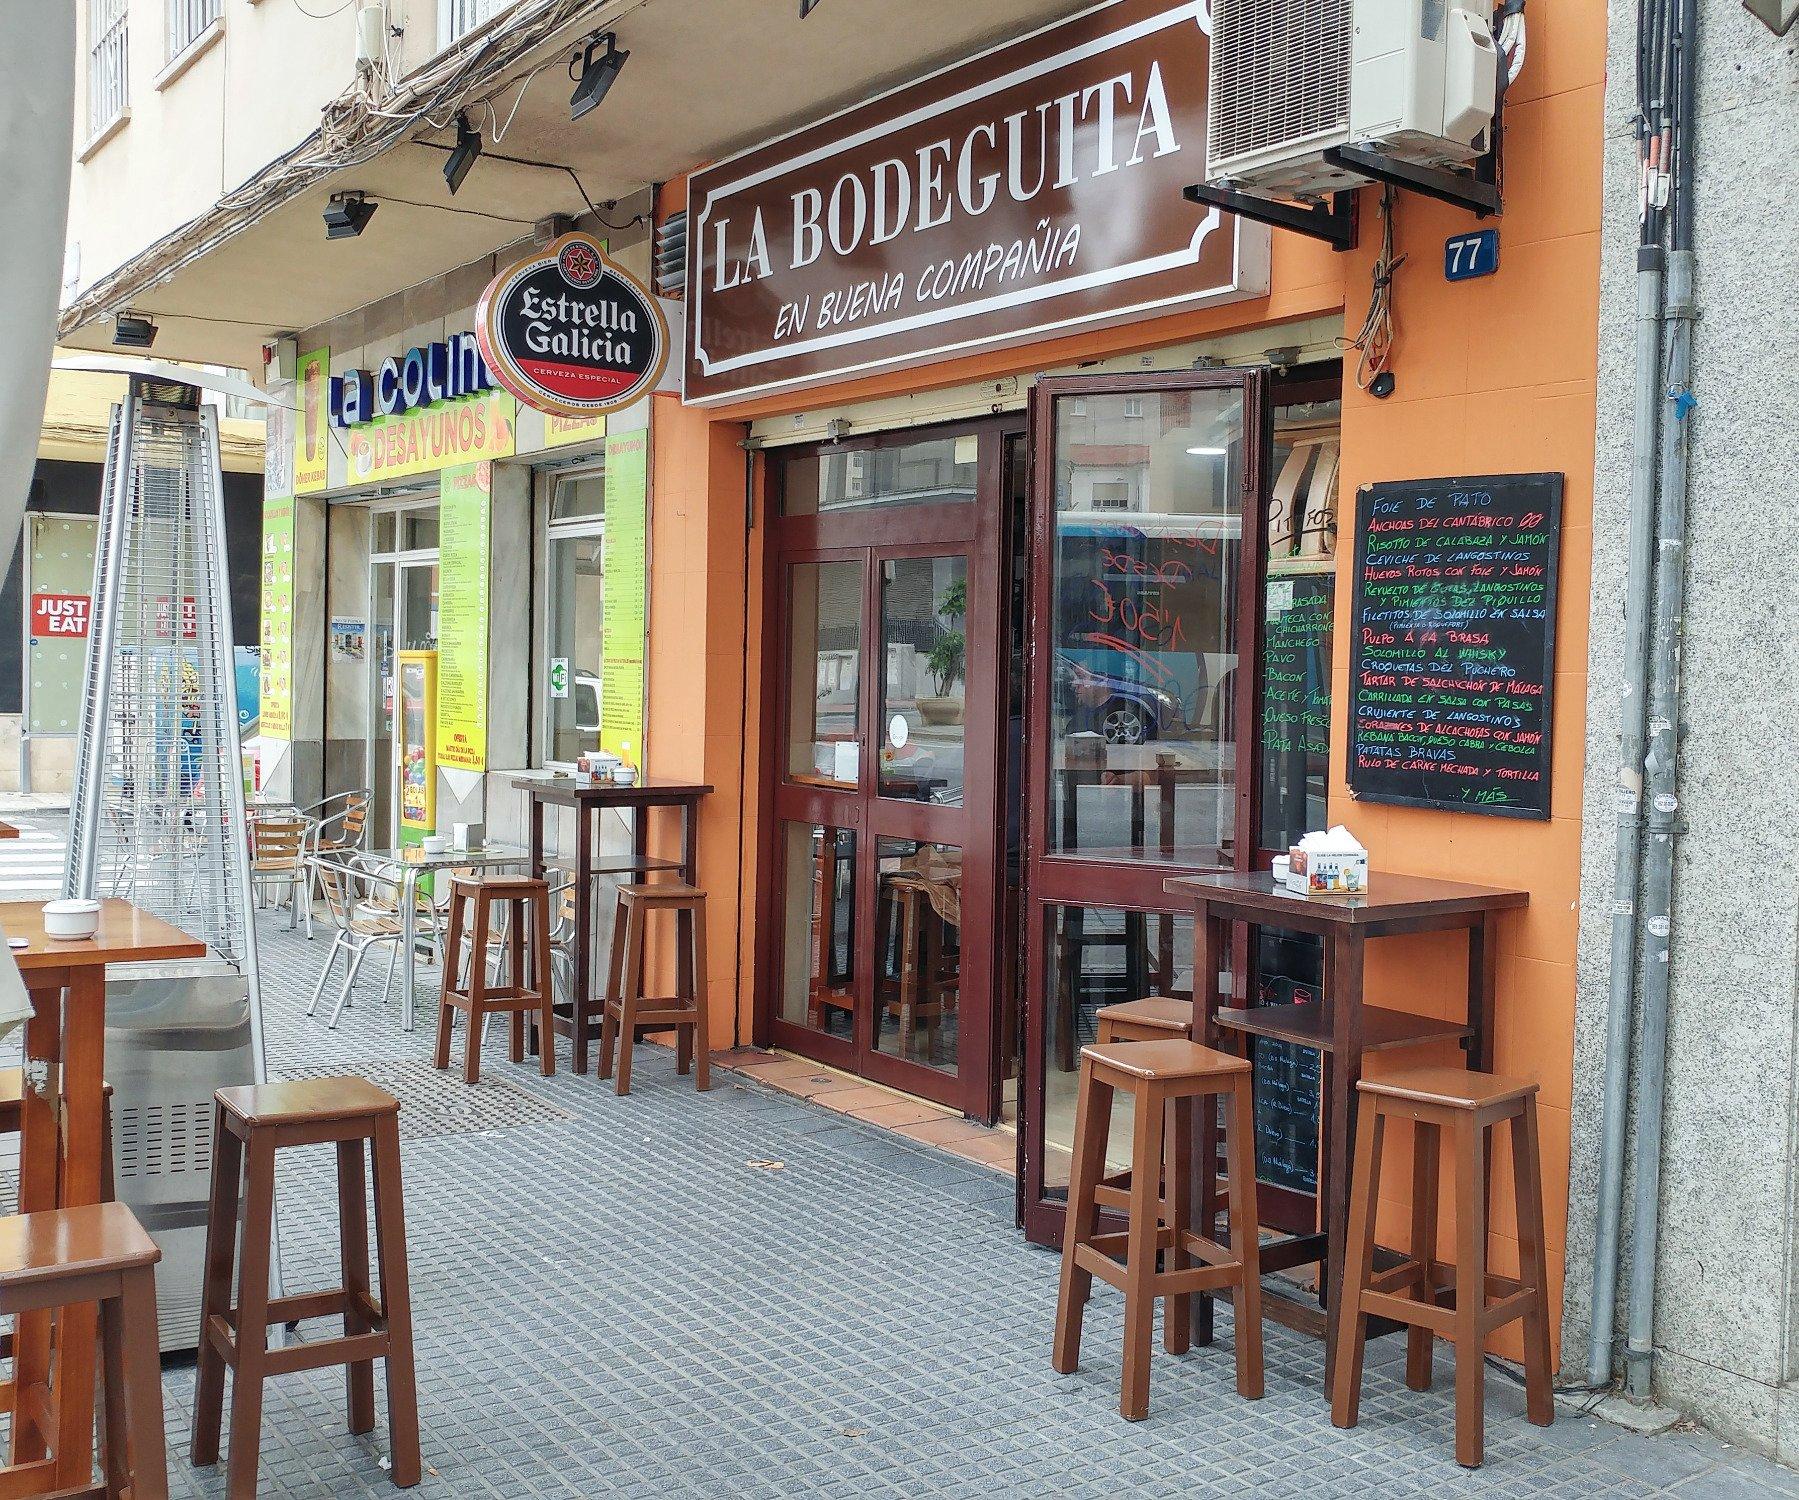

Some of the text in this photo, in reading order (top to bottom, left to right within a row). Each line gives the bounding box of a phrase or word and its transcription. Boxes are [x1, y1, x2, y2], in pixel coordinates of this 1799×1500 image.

[713, 60, 1181, 293] LA BODEGUITA
[1449, 238, 1482, 273] 77
[520, 287, 638, 333] Estrella
[773, 293, 809, 341] EN
[816, 273, 904, 331] BUENA
[525, 321, 633, 365] Galicia
[533, 368, 622, 384] CERVEZA ESPECIAL
[374, 403, 486, 469] DESAYUNOS
[1372, 492, 1491, 516] FOIE DE PATO
[1367, 517, 1414, 532] ANCHOAS
[1419, 518, 1440, 529] DEL
[1367, 534, 1411, 554] RISOTTO
[1415, 538, 1431, 547] DE
[1436, 534, 1493, 547] CALABAZA
[1499, 534, 1508, 545] Y
[1366, 551, 1531, 565] CEVICHE DE LANGOSTINOS
[1364, 568, 1402, 581] HUEVOS
[1406, 567, 1440, 578] ROTOS
[1444, 566, 1464, 576] CON
[1470, 565, 1495, 576] FOIE
[1499, 566, 1508, 576] Y
[1364, 582, 1409, 597] REVUELTO
[1413, 584, 1428, 594] DE
[1473, 581, 1545, 593] LANGOSTINOS
[37, 599, 88, 617] JUST
[1379, 597, 1387, 607] Y
[1451, 596, 1476, 607] DEL
[1481, 594, 1541, 607] PIQUILLO
[1309, 610, 1333, 621] CON
[1362, 607, 1546, 623] FILETITOS DE SOLOMILLO EN SALSA
[49, 616, 87, 633] EAT
[1266, 634, 1320, 649] MANCHEGO
[1362, 628, 1490, 645] PULPO A LA BRASA
[1361, 646, 1507, 661] SOLOMILLO AL WHISKY
[1361, 659, 1516, 677] CROQUETAS DEL PUCHERO
[1359, 671, 1396, 686] TARTAR
[1401, 676, 1416, 687] DE
[1489, 682, 1503, 693] DE
[1358, 690, 1533, 712] CARRILLADA EN SALSA CON PASAS
[1358, 706, 1521, 728] CRUJIENTE DE LANGOSTINOS
[1417, 722, 1433, 733] DE
[1435, 723, 1490, 738] ALCACHOFAS
[1493, 730, 1511, 741] CON
[1356, 744, 1456, 761] PATATAS BRAVAS
[1458, 739, 1485, 749] CABRA
[1494, 742, 1535, 755] CEBOLLA
[1358, 755, 1540, 781] RULO DE CARNE MECHADA Y TORTILLA
